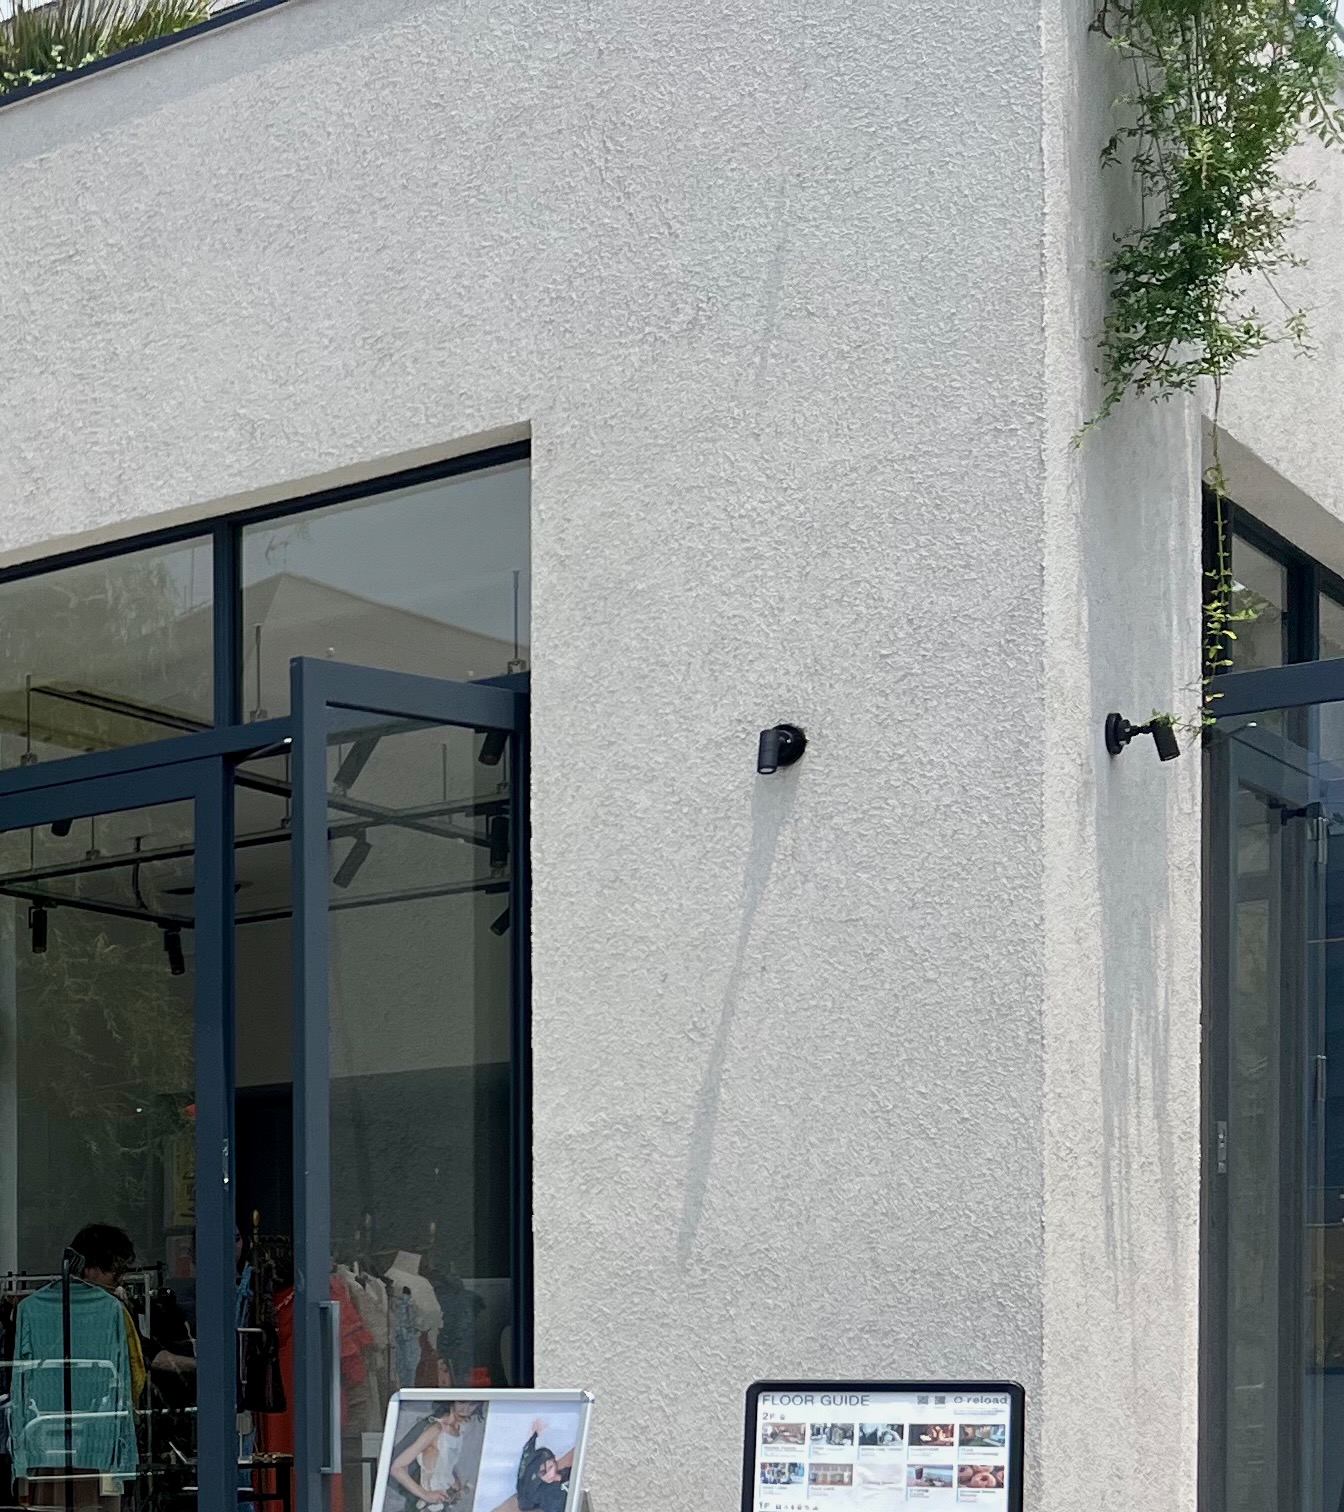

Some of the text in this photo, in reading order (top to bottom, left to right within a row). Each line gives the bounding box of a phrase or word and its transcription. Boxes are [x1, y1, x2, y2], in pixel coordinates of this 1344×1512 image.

[762, 1394, 870, 1406] FLOOR GUIDE
[967, 1395, 1008, 1404] reload
